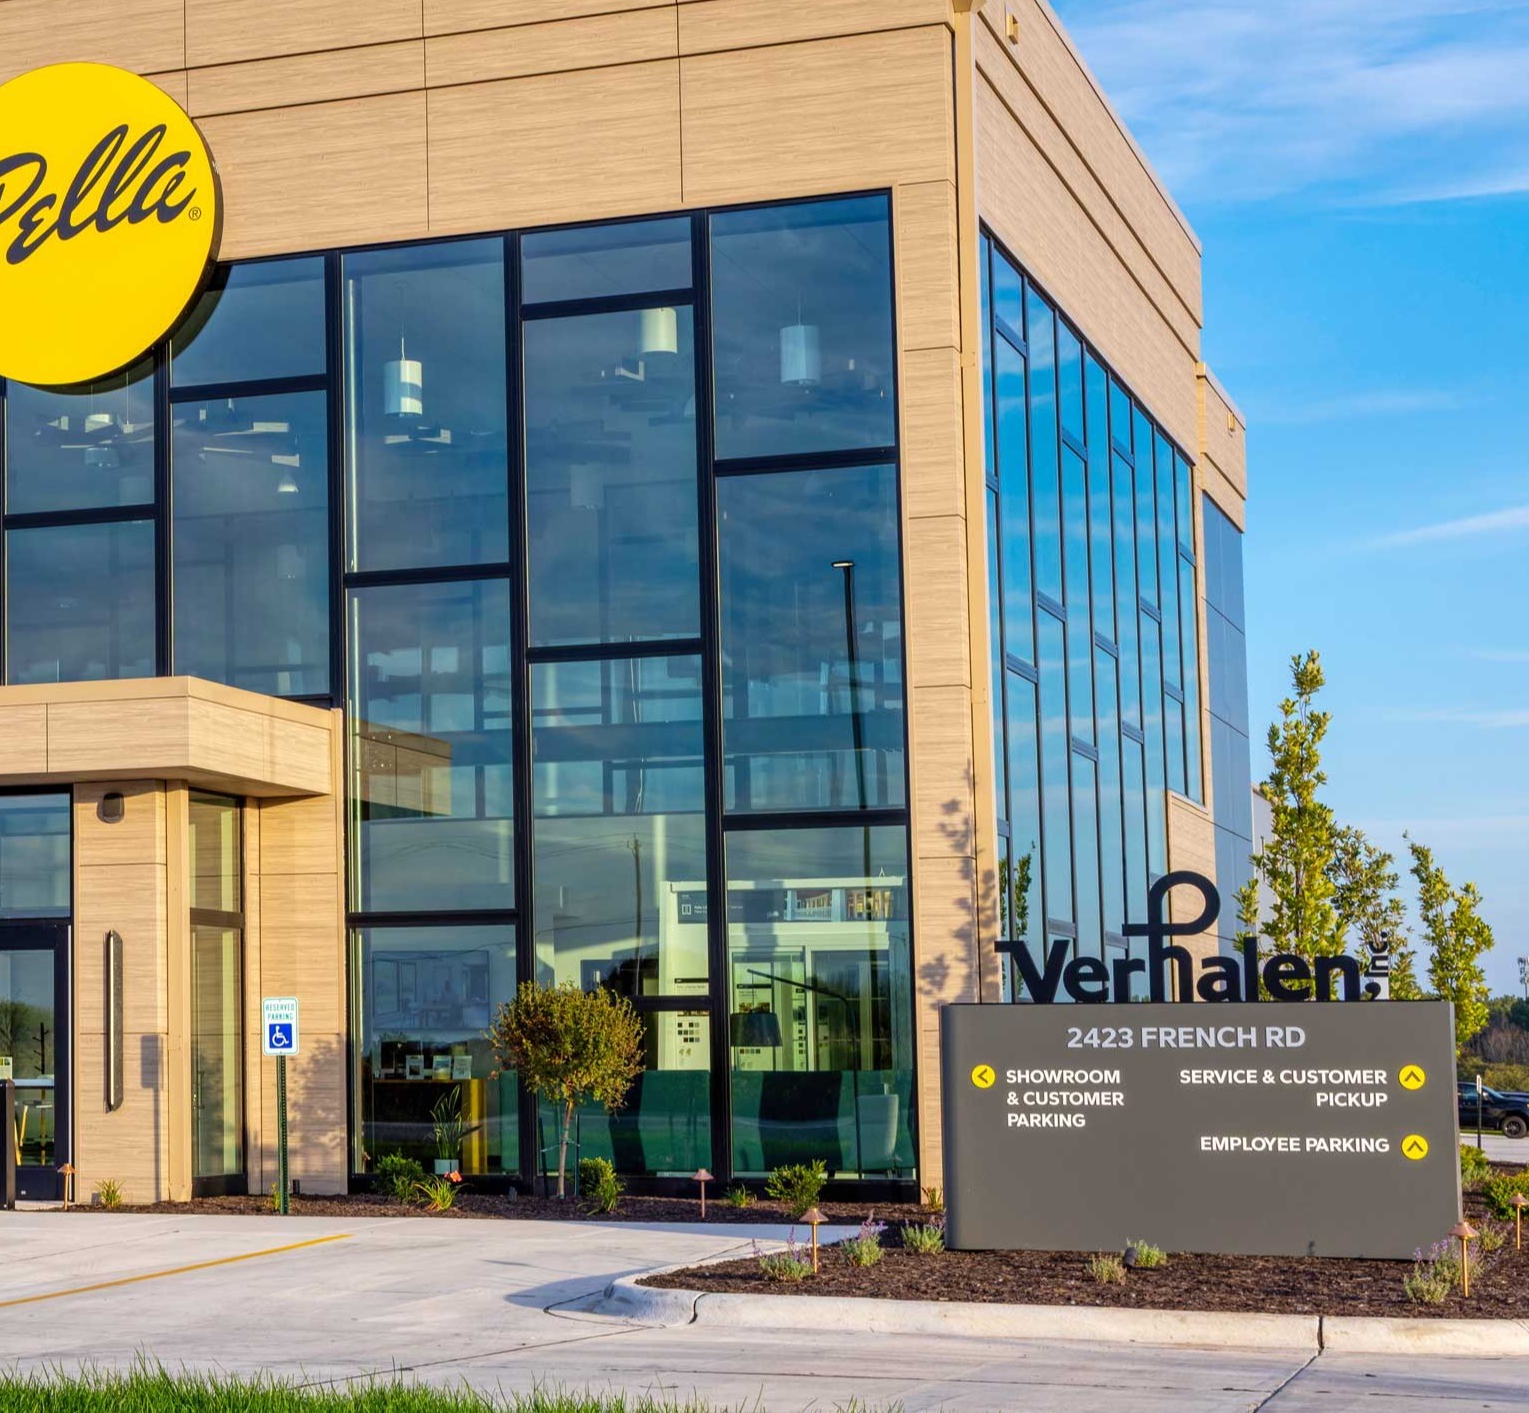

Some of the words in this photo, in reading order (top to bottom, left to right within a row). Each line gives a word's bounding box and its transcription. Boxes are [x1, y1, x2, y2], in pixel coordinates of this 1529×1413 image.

[265, 1003, 295, 1012] RESERVED
[267, 1012, 294, 1021] PARKING
[1067, 1027, 1134, 1048] 2423
[1141, 1027, 1257, 1048] FRENCH
[1265, 1026, 1306, 1048] RD
[1006, 1069, 1121, 1084] SHOWROOM
[1179, 1069, 1258, 1084] SERVICE
[1262, 1070, 1276, 1084] &
[1279, 1069, 1387, 1084] CUSTOMER
[1006, 1091, 1019, 1105] &
[1023, 1091, 1125, 1106] CUSTOMER
[1316, 1092, 1388, 1107] PICKUP
[1007, 1113, 1086, 1128] PARKING
[1200, 1136, 1301, 1152] EMPLOYEE
[1305, 1137, 1390, 1153] PARKING
